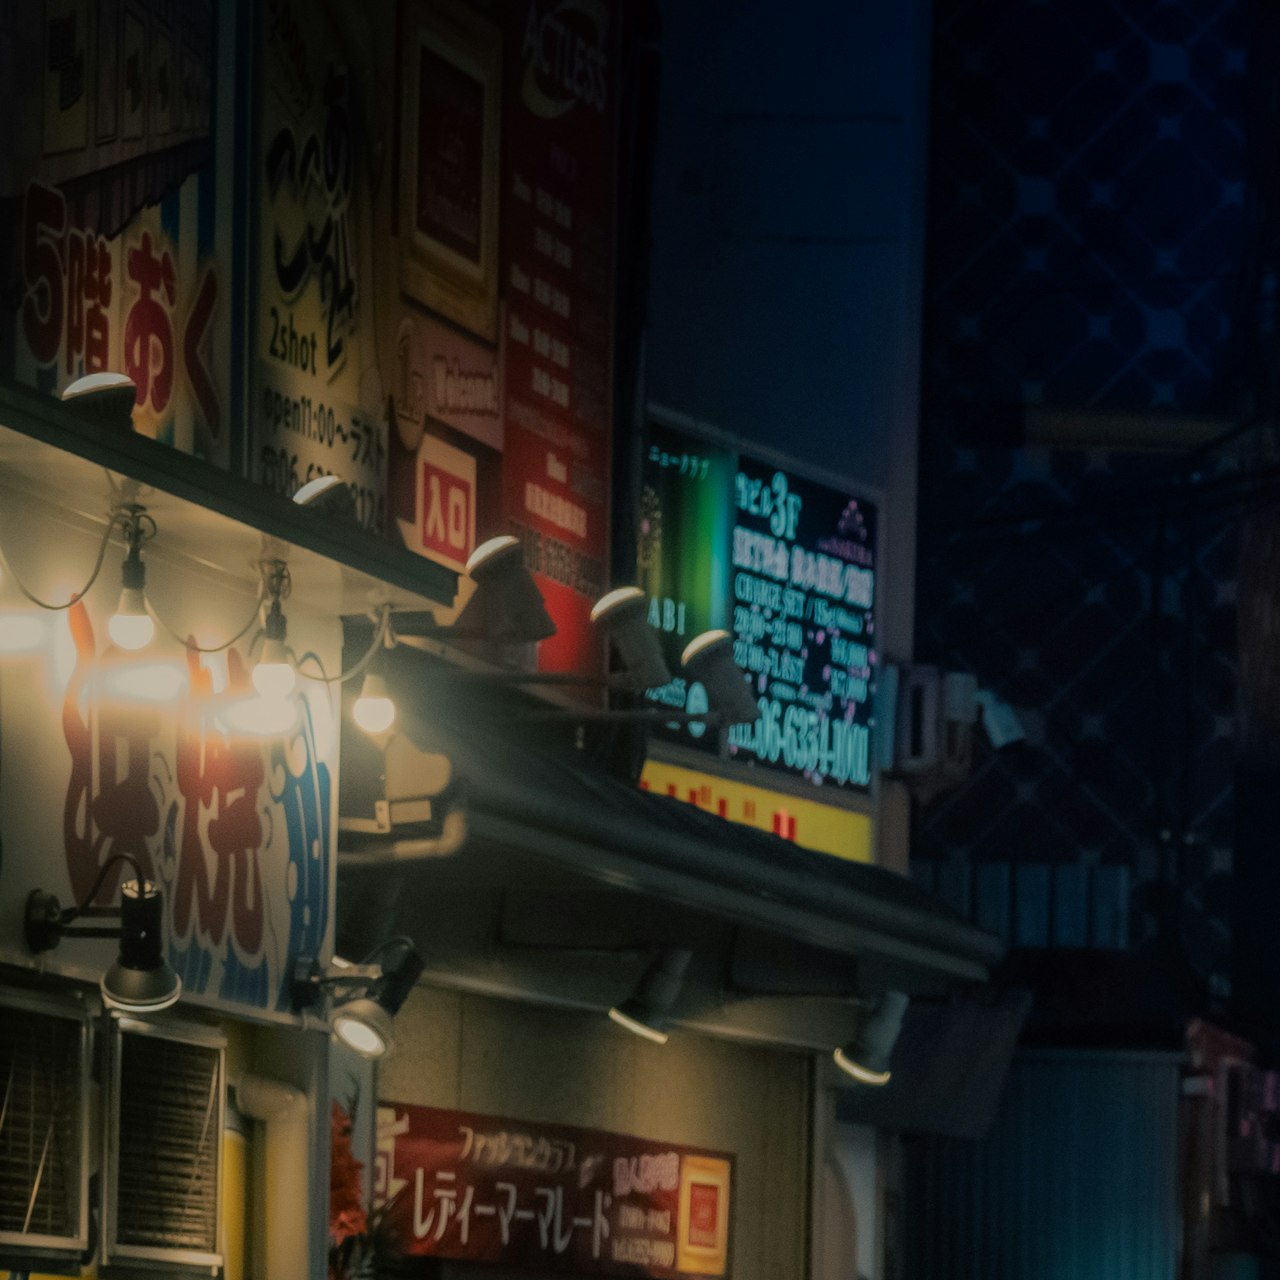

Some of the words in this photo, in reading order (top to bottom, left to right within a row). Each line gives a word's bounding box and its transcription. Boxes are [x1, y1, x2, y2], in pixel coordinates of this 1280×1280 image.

[269, 306, 317, 376] 2shot
[427, 475, 466, 552] 入口
[413, 1168, 611, 1260] レディーマーマレード
